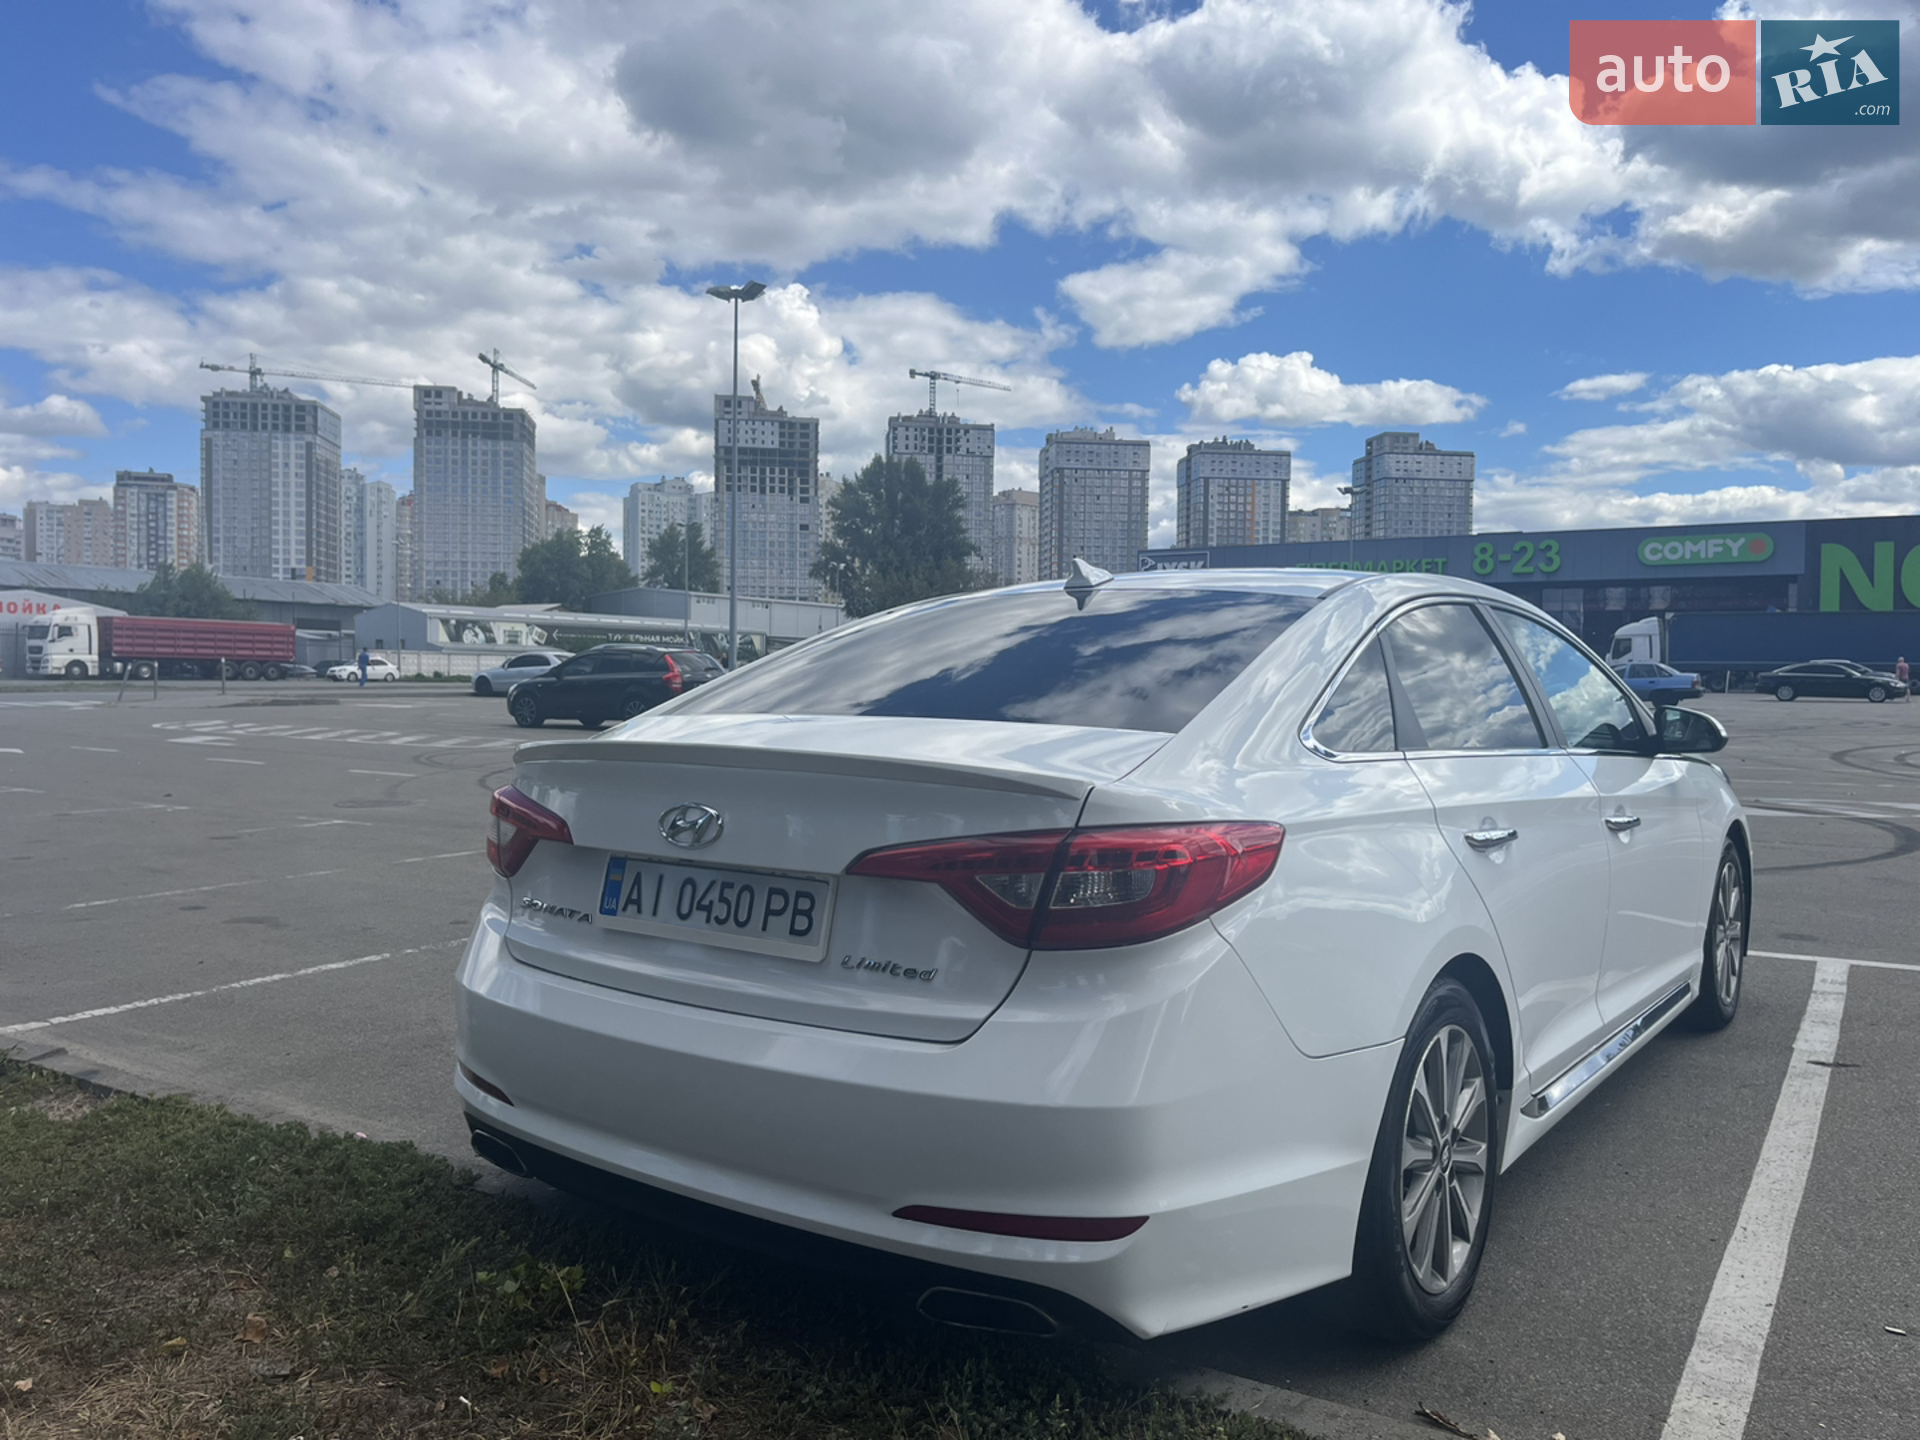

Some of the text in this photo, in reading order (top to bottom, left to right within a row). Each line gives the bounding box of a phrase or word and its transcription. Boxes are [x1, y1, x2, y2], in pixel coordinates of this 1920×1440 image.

[1472, 540, 1561, 575] 8-23
[1643, 537, 1746, 562] COMFY
[1820, 541, 1920, 612] N
[521, 896, 592, 924] SONATA
[604, 897, 617, 911] UA
[622, 871, 816, 936] AI 0450 PB
[841, 955, 938, 981] Limited
